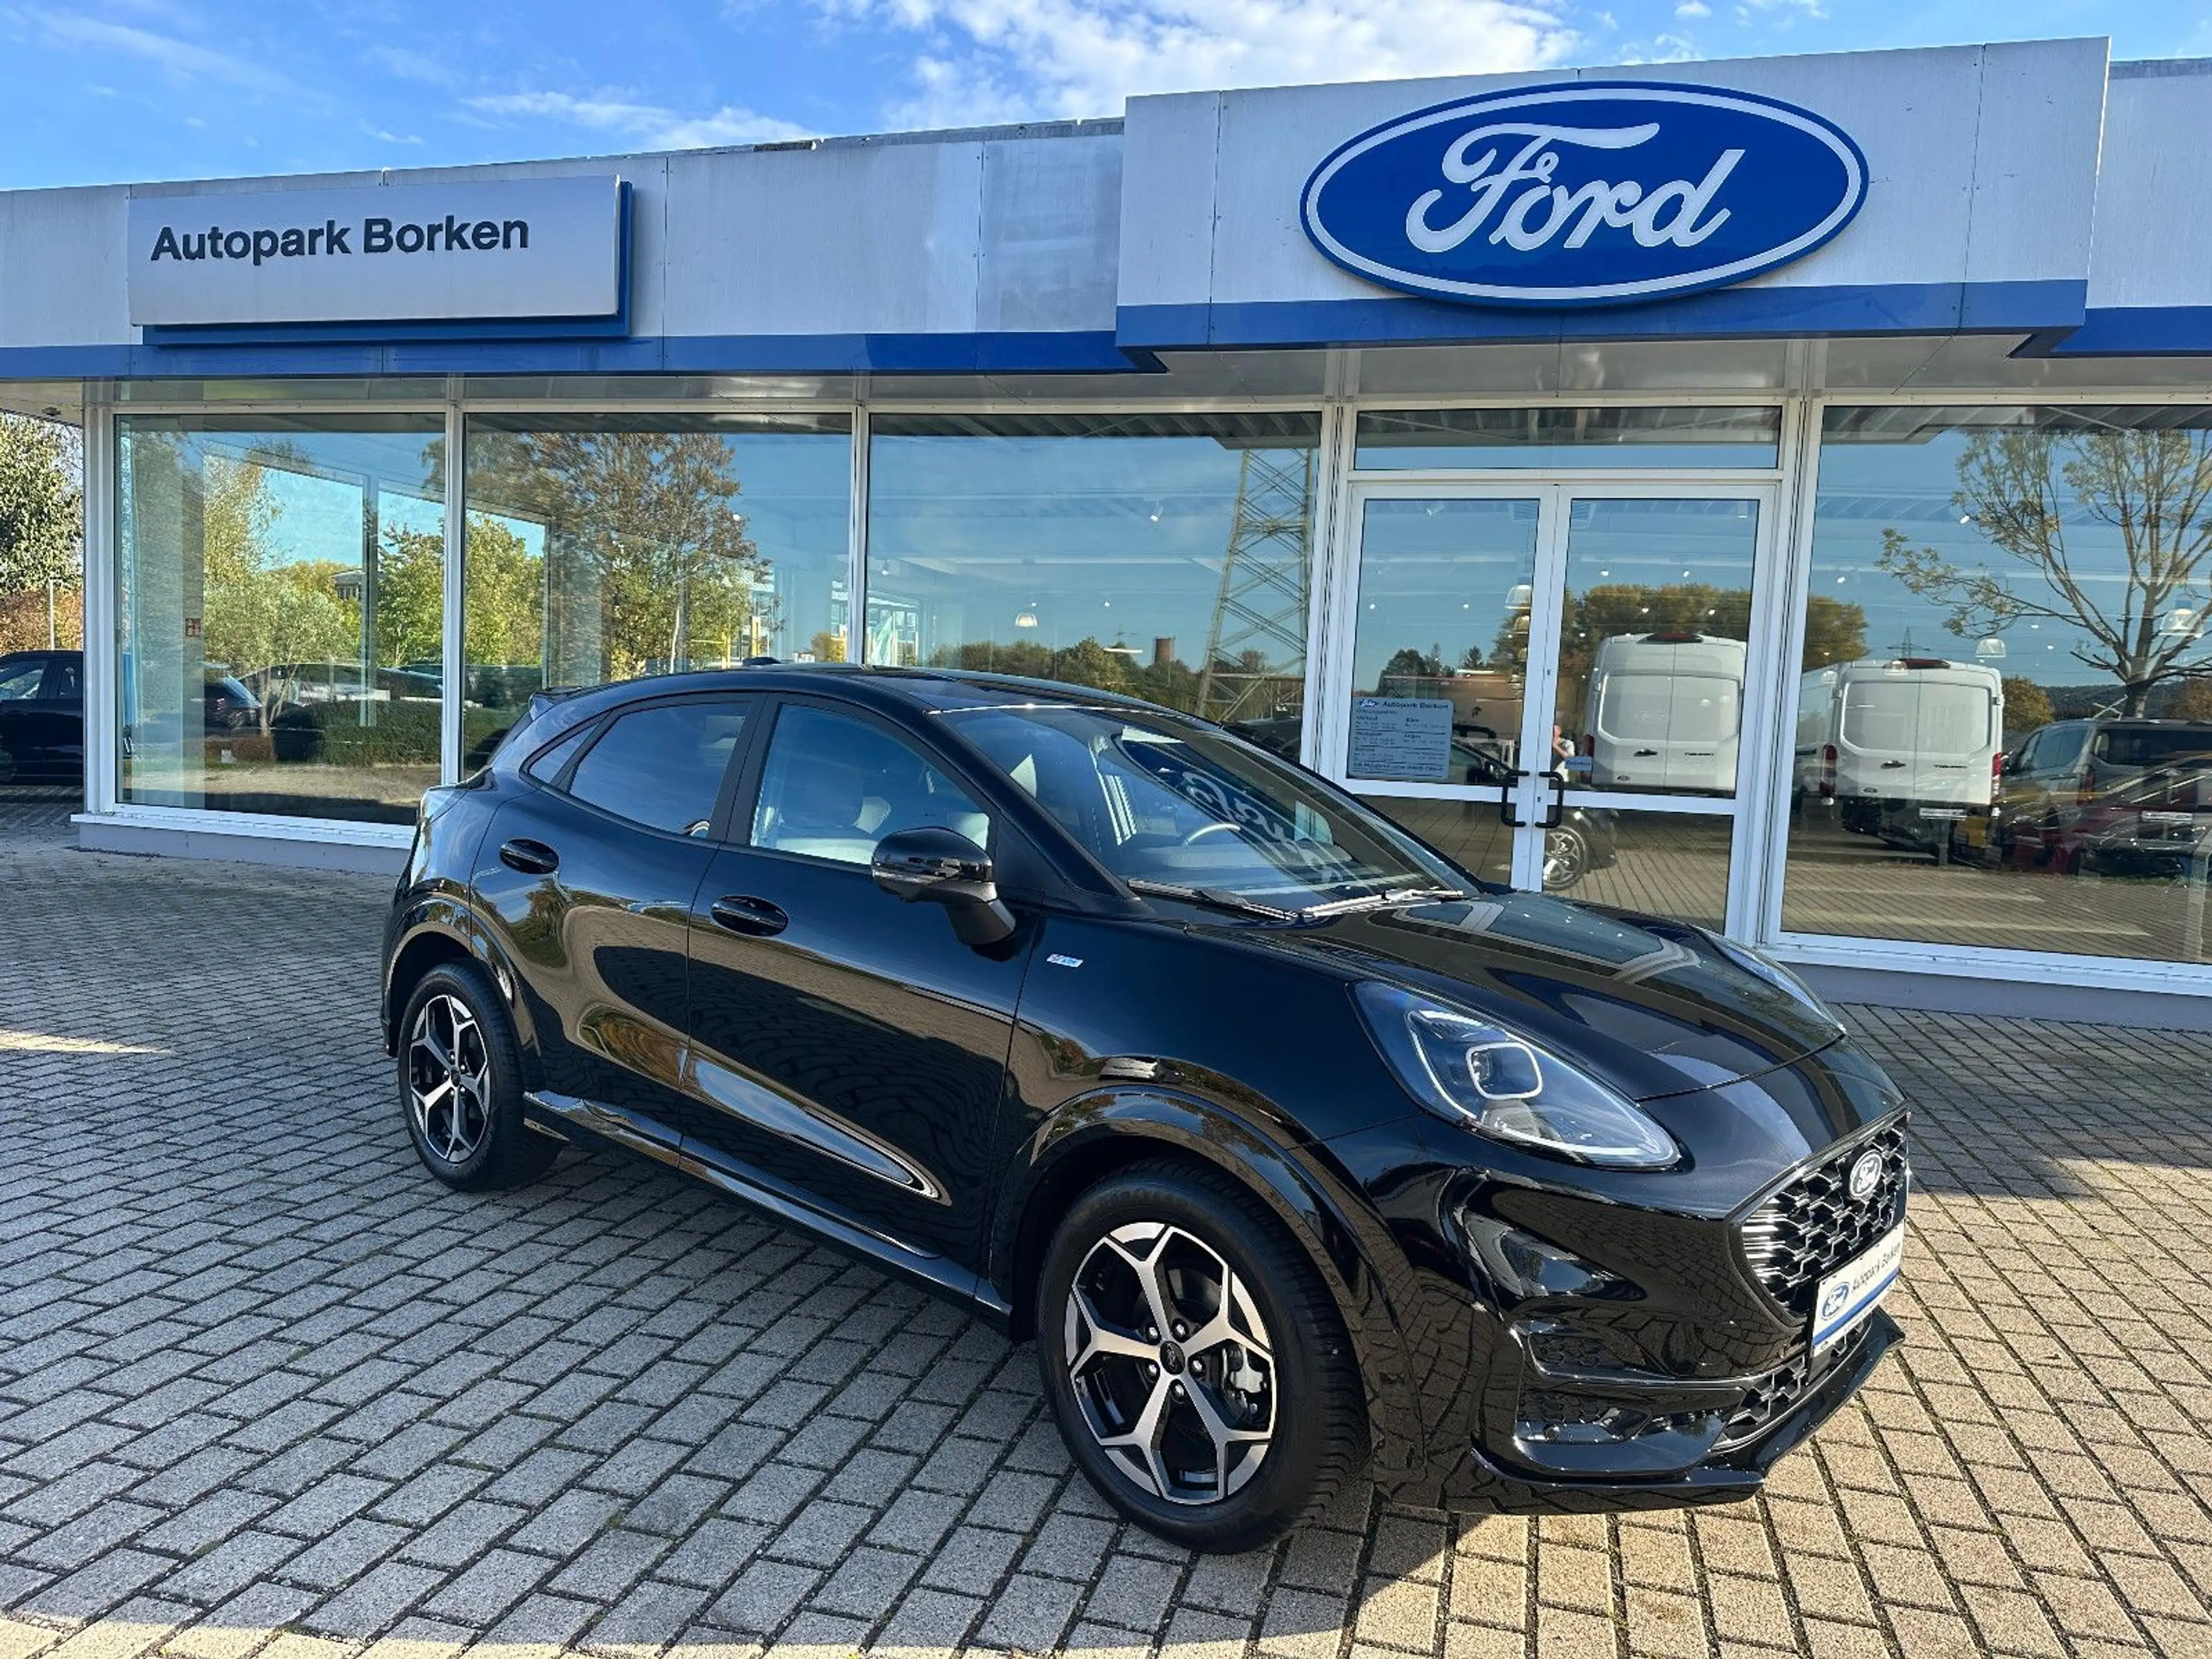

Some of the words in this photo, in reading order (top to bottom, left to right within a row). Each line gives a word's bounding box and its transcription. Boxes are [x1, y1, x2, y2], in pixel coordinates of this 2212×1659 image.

[1406, 122, 1745, 252] Ford
[150, 220, 352, 266] Autopark
[363, 215, 529, 253] Borken
